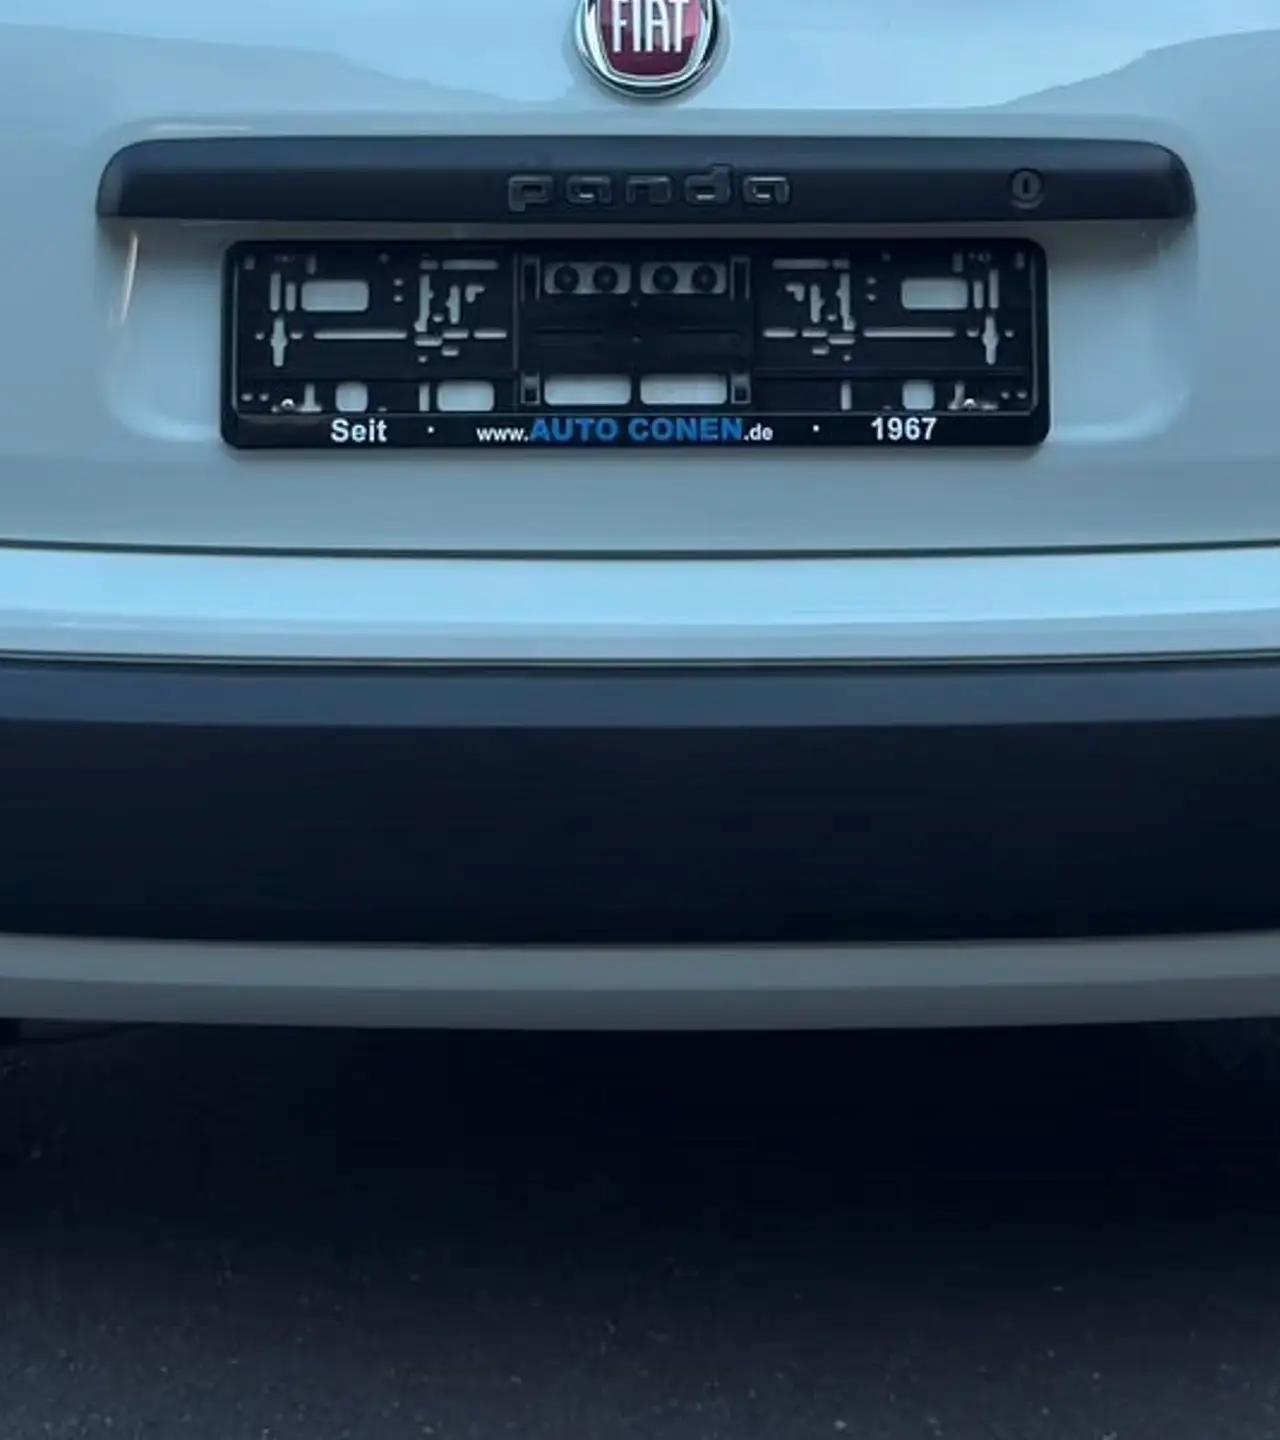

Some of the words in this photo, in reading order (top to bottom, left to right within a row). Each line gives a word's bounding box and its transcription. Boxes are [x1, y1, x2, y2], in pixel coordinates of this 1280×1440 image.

[507, 163, 791, 213] panda
[330, 417, 388, 443] Seit
[871, 417, 938, 442] 1967
